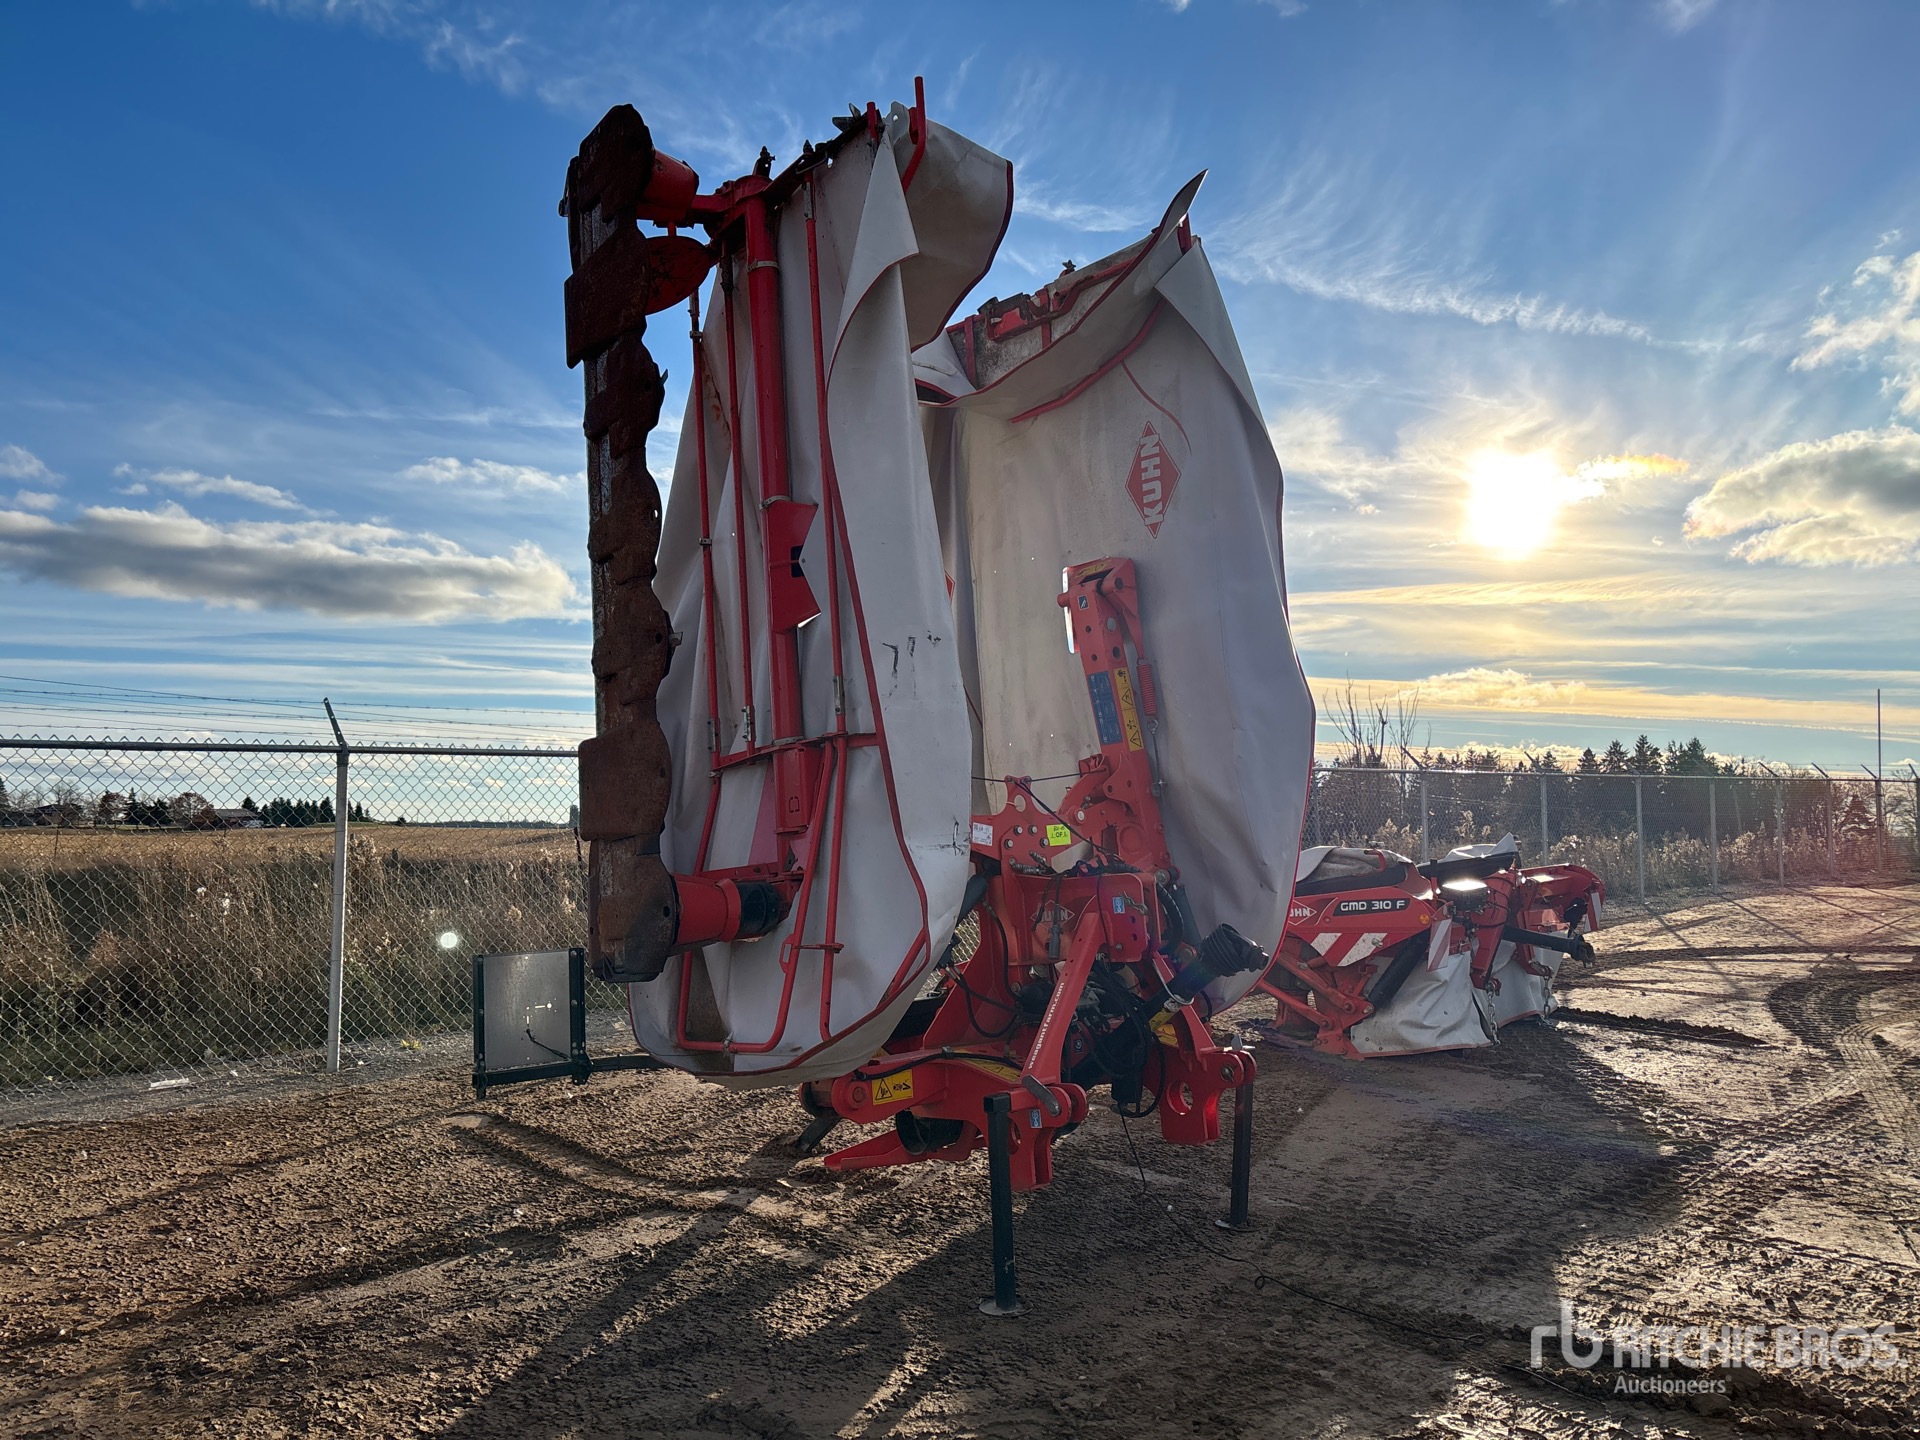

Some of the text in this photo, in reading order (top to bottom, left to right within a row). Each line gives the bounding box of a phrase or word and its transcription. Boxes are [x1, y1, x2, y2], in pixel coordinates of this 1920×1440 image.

[1140, 433, 1164, 527] KUHN
[1290, 907, 1311, 917] UHN
[1340, 900, 1405, 911] GMD 310 F
[1028, 982, 1065, 1070] weagantfarm.com
